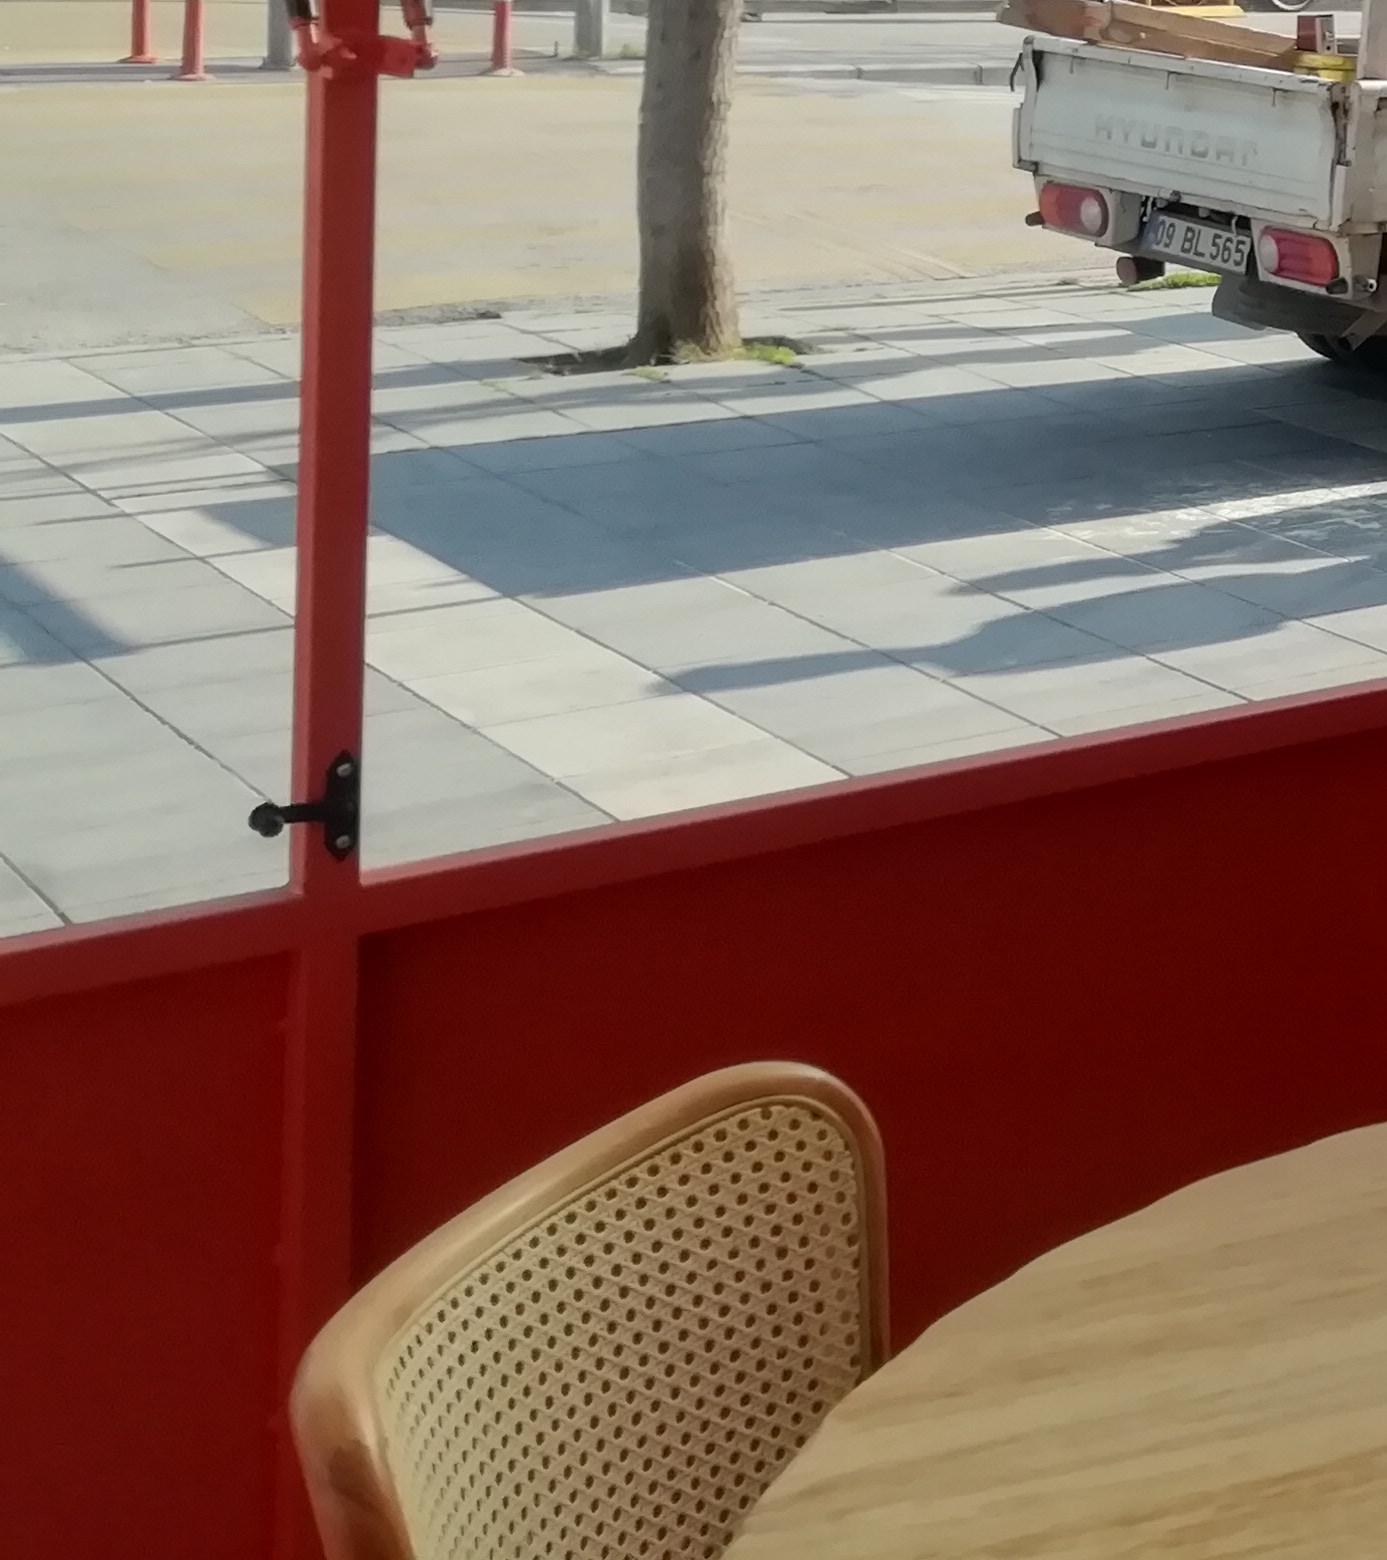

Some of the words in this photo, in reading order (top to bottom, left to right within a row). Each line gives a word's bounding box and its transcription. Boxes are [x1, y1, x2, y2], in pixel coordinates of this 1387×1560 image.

[1155, 218, 1176, 249] 09
[1181, 226, 1205, 258] BL
[1210, 232, 1247, 267] 565
